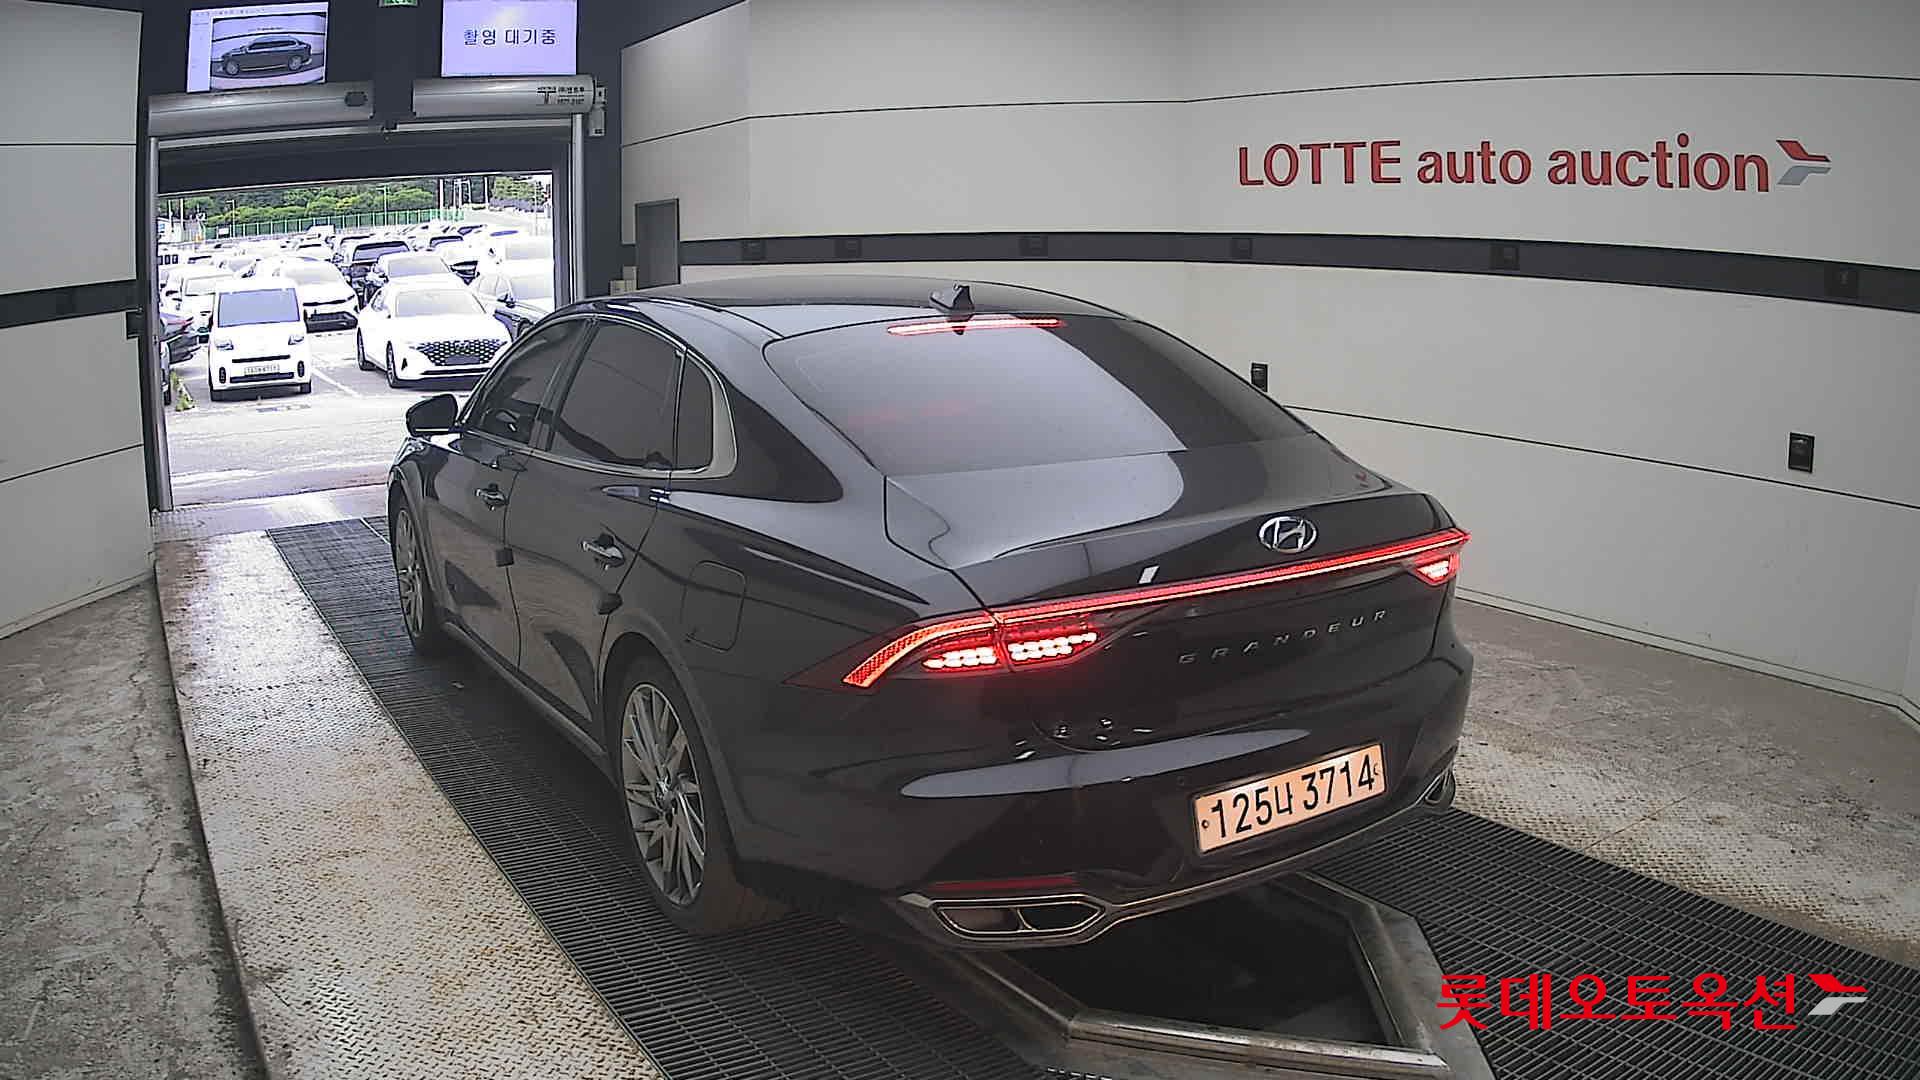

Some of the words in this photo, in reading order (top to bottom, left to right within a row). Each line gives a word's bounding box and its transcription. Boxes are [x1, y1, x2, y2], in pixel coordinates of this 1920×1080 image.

[505, 29, 556, 45] 대기중
[1238, 140, 1401, 187] LOTTE
[1417, 140, 1533, 185] auto
[1547, 132, 1770, 193] auction
[1178, 609, 1387, 665] GRANDEUR
[1211, 782, 1293, 838] 125나
[1301, 754, 1375, 810] 3714
